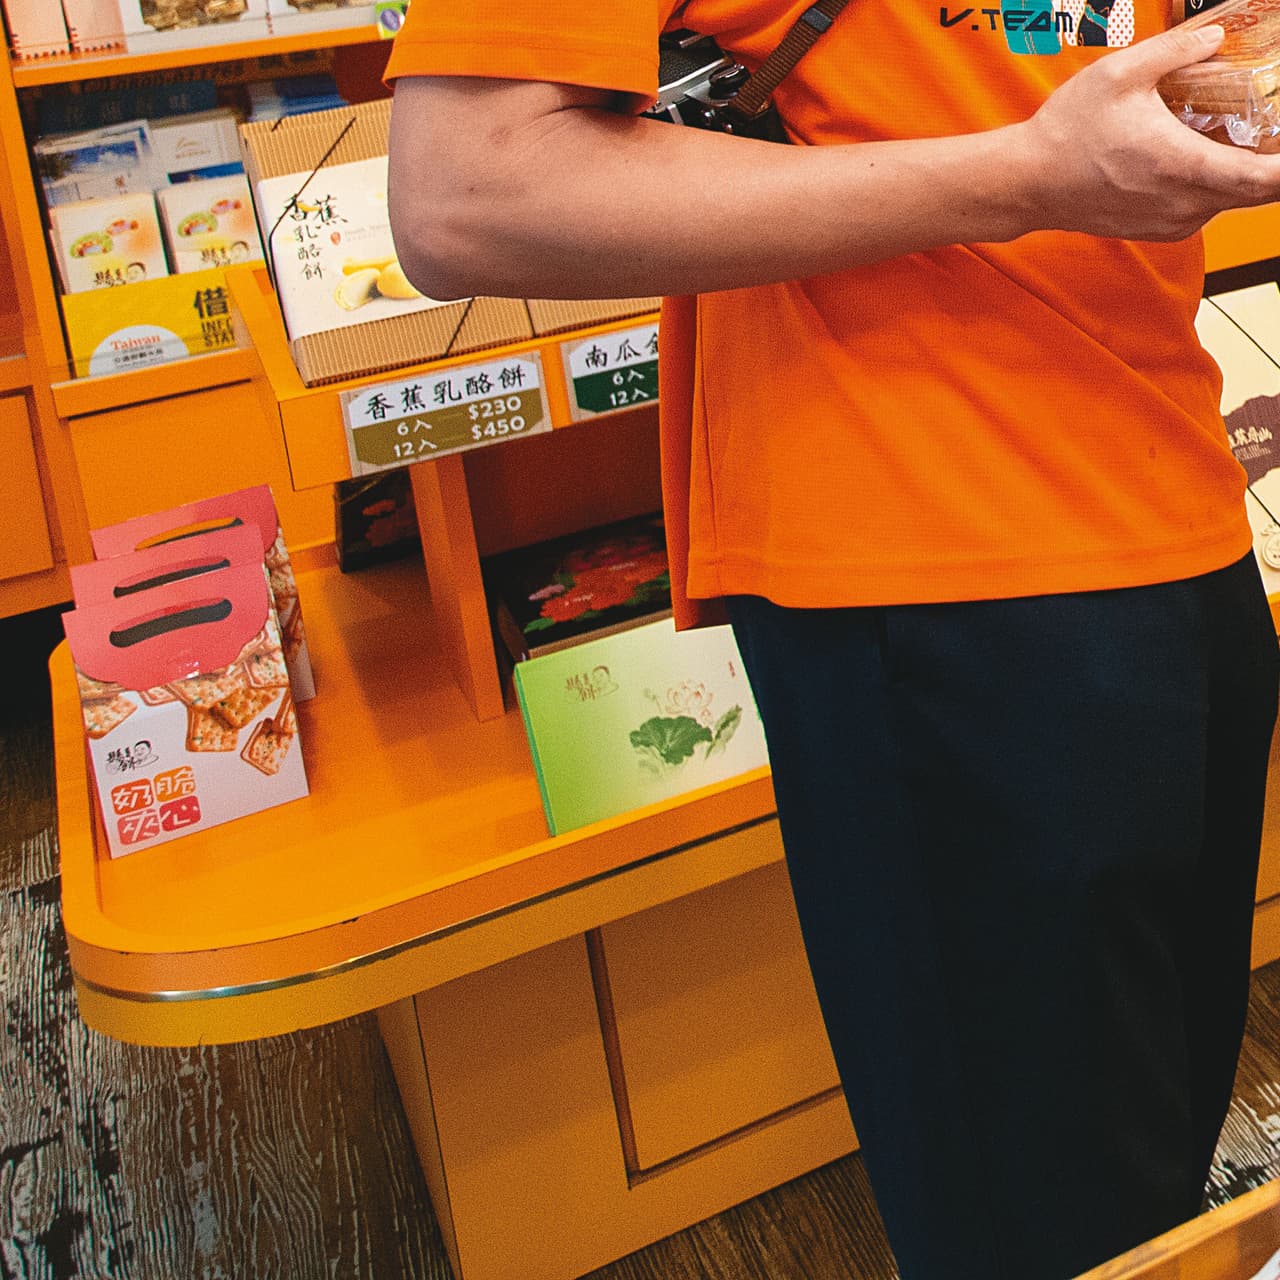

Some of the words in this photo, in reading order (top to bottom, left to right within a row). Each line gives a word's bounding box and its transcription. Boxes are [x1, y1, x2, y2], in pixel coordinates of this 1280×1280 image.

[110, 335, 161, 351] Taiwan
[364, 364, 527, 421] 香蕉乳酪餅
[612, 369, 645, 386] 6入
[609, 387, 650, 406] 12入
[396, 419, 433, 437] 6入
[467, 395, 523, 421] $230
[393, 438, 438, 458] 12入
[471, 414, 526, 441] $450
